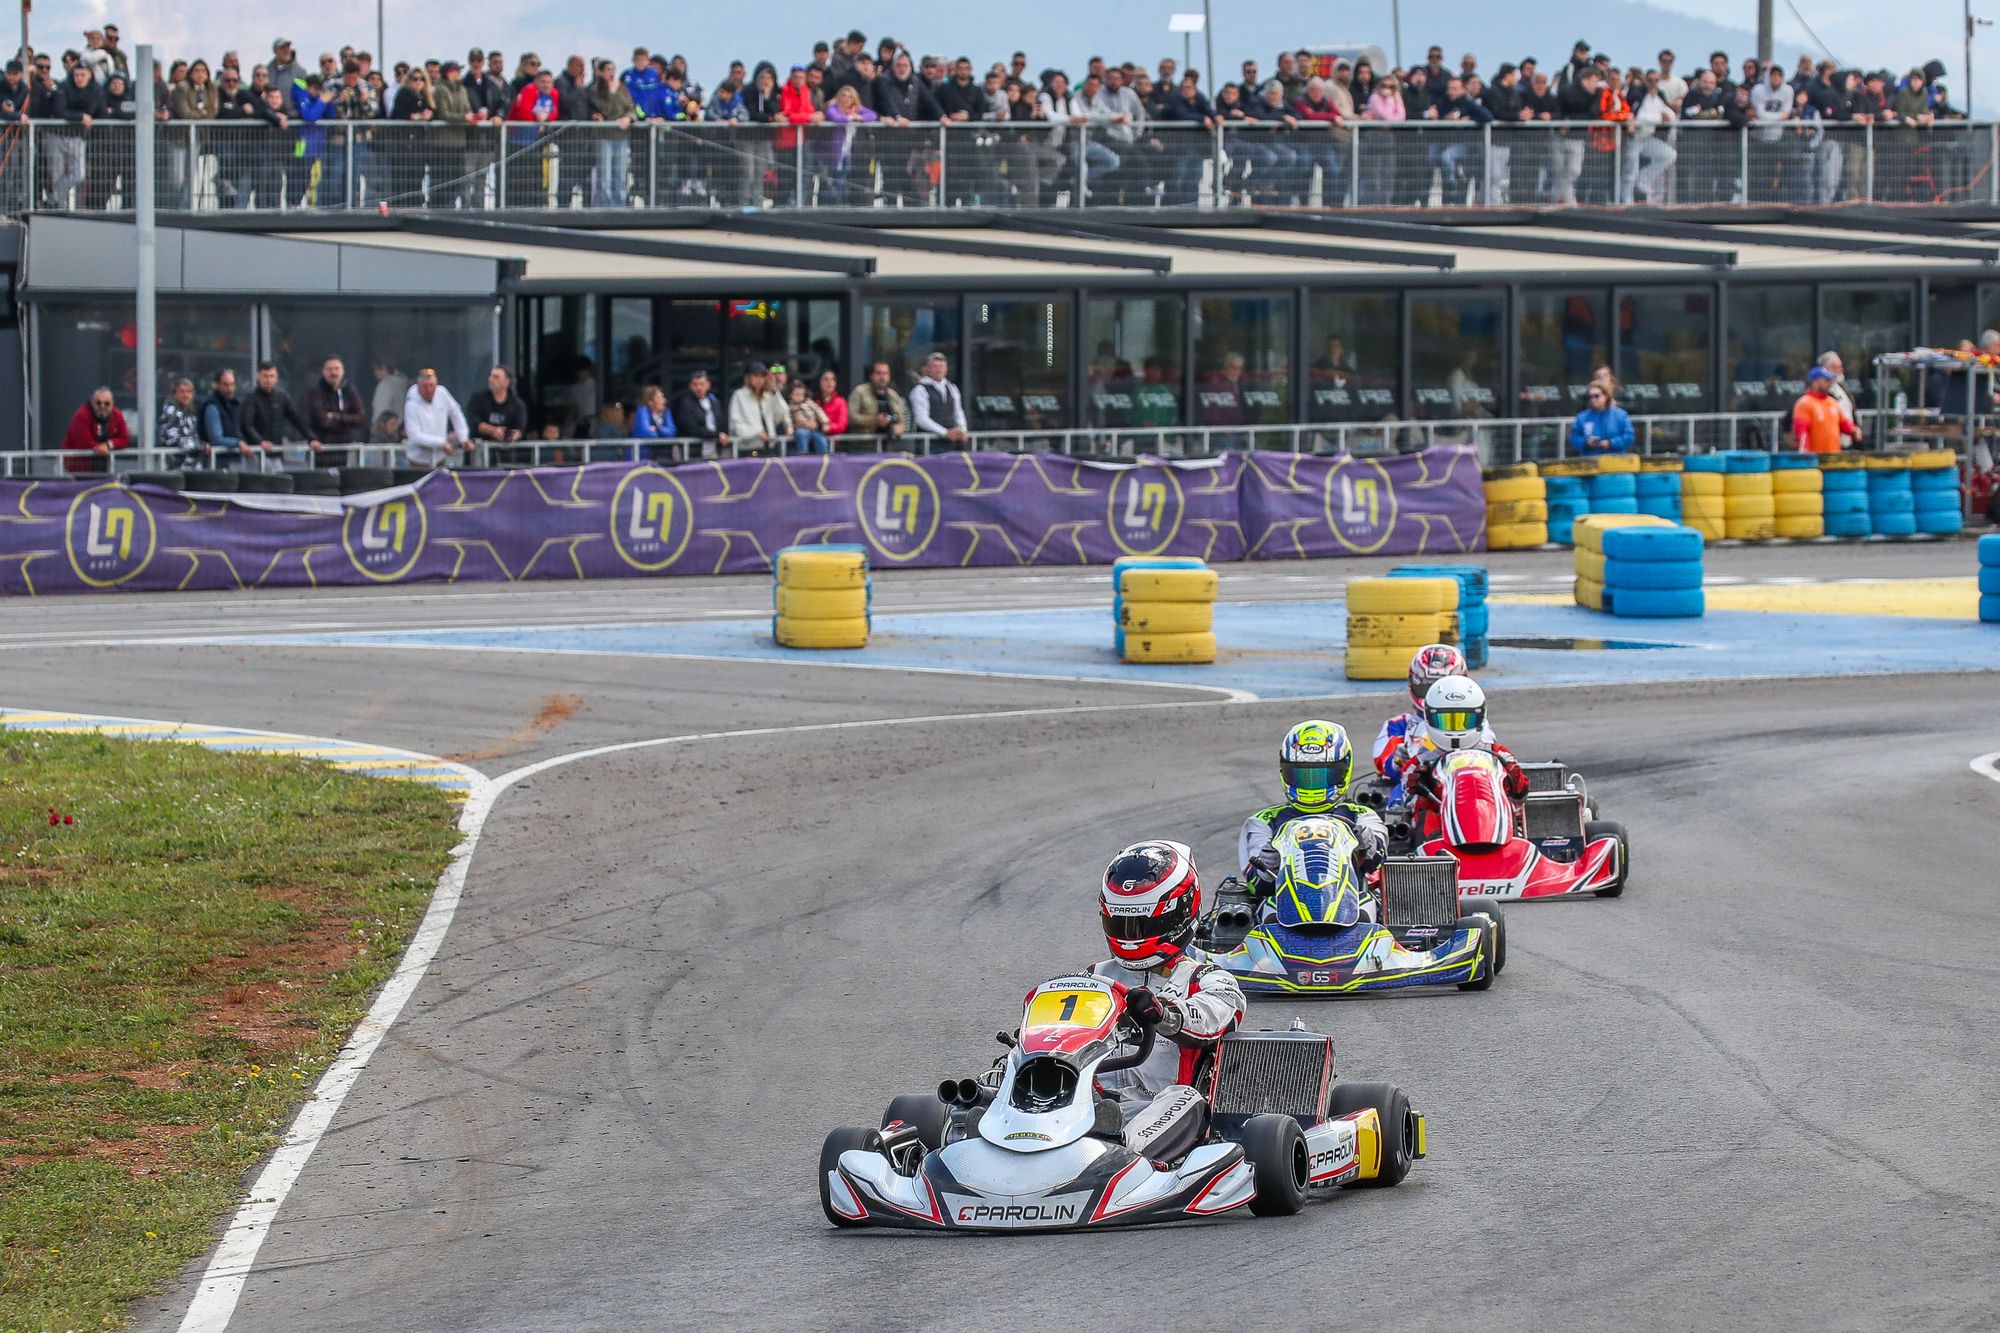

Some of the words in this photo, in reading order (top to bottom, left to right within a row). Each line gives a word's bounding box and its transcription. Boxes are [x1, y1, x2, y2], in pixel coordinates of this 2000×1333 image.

[1459, 882, 1515, 896] relart
[1059, 994, 1079, 1021] 1
[1137, 1087, 1198, 1138] SOTIROPOULOS
